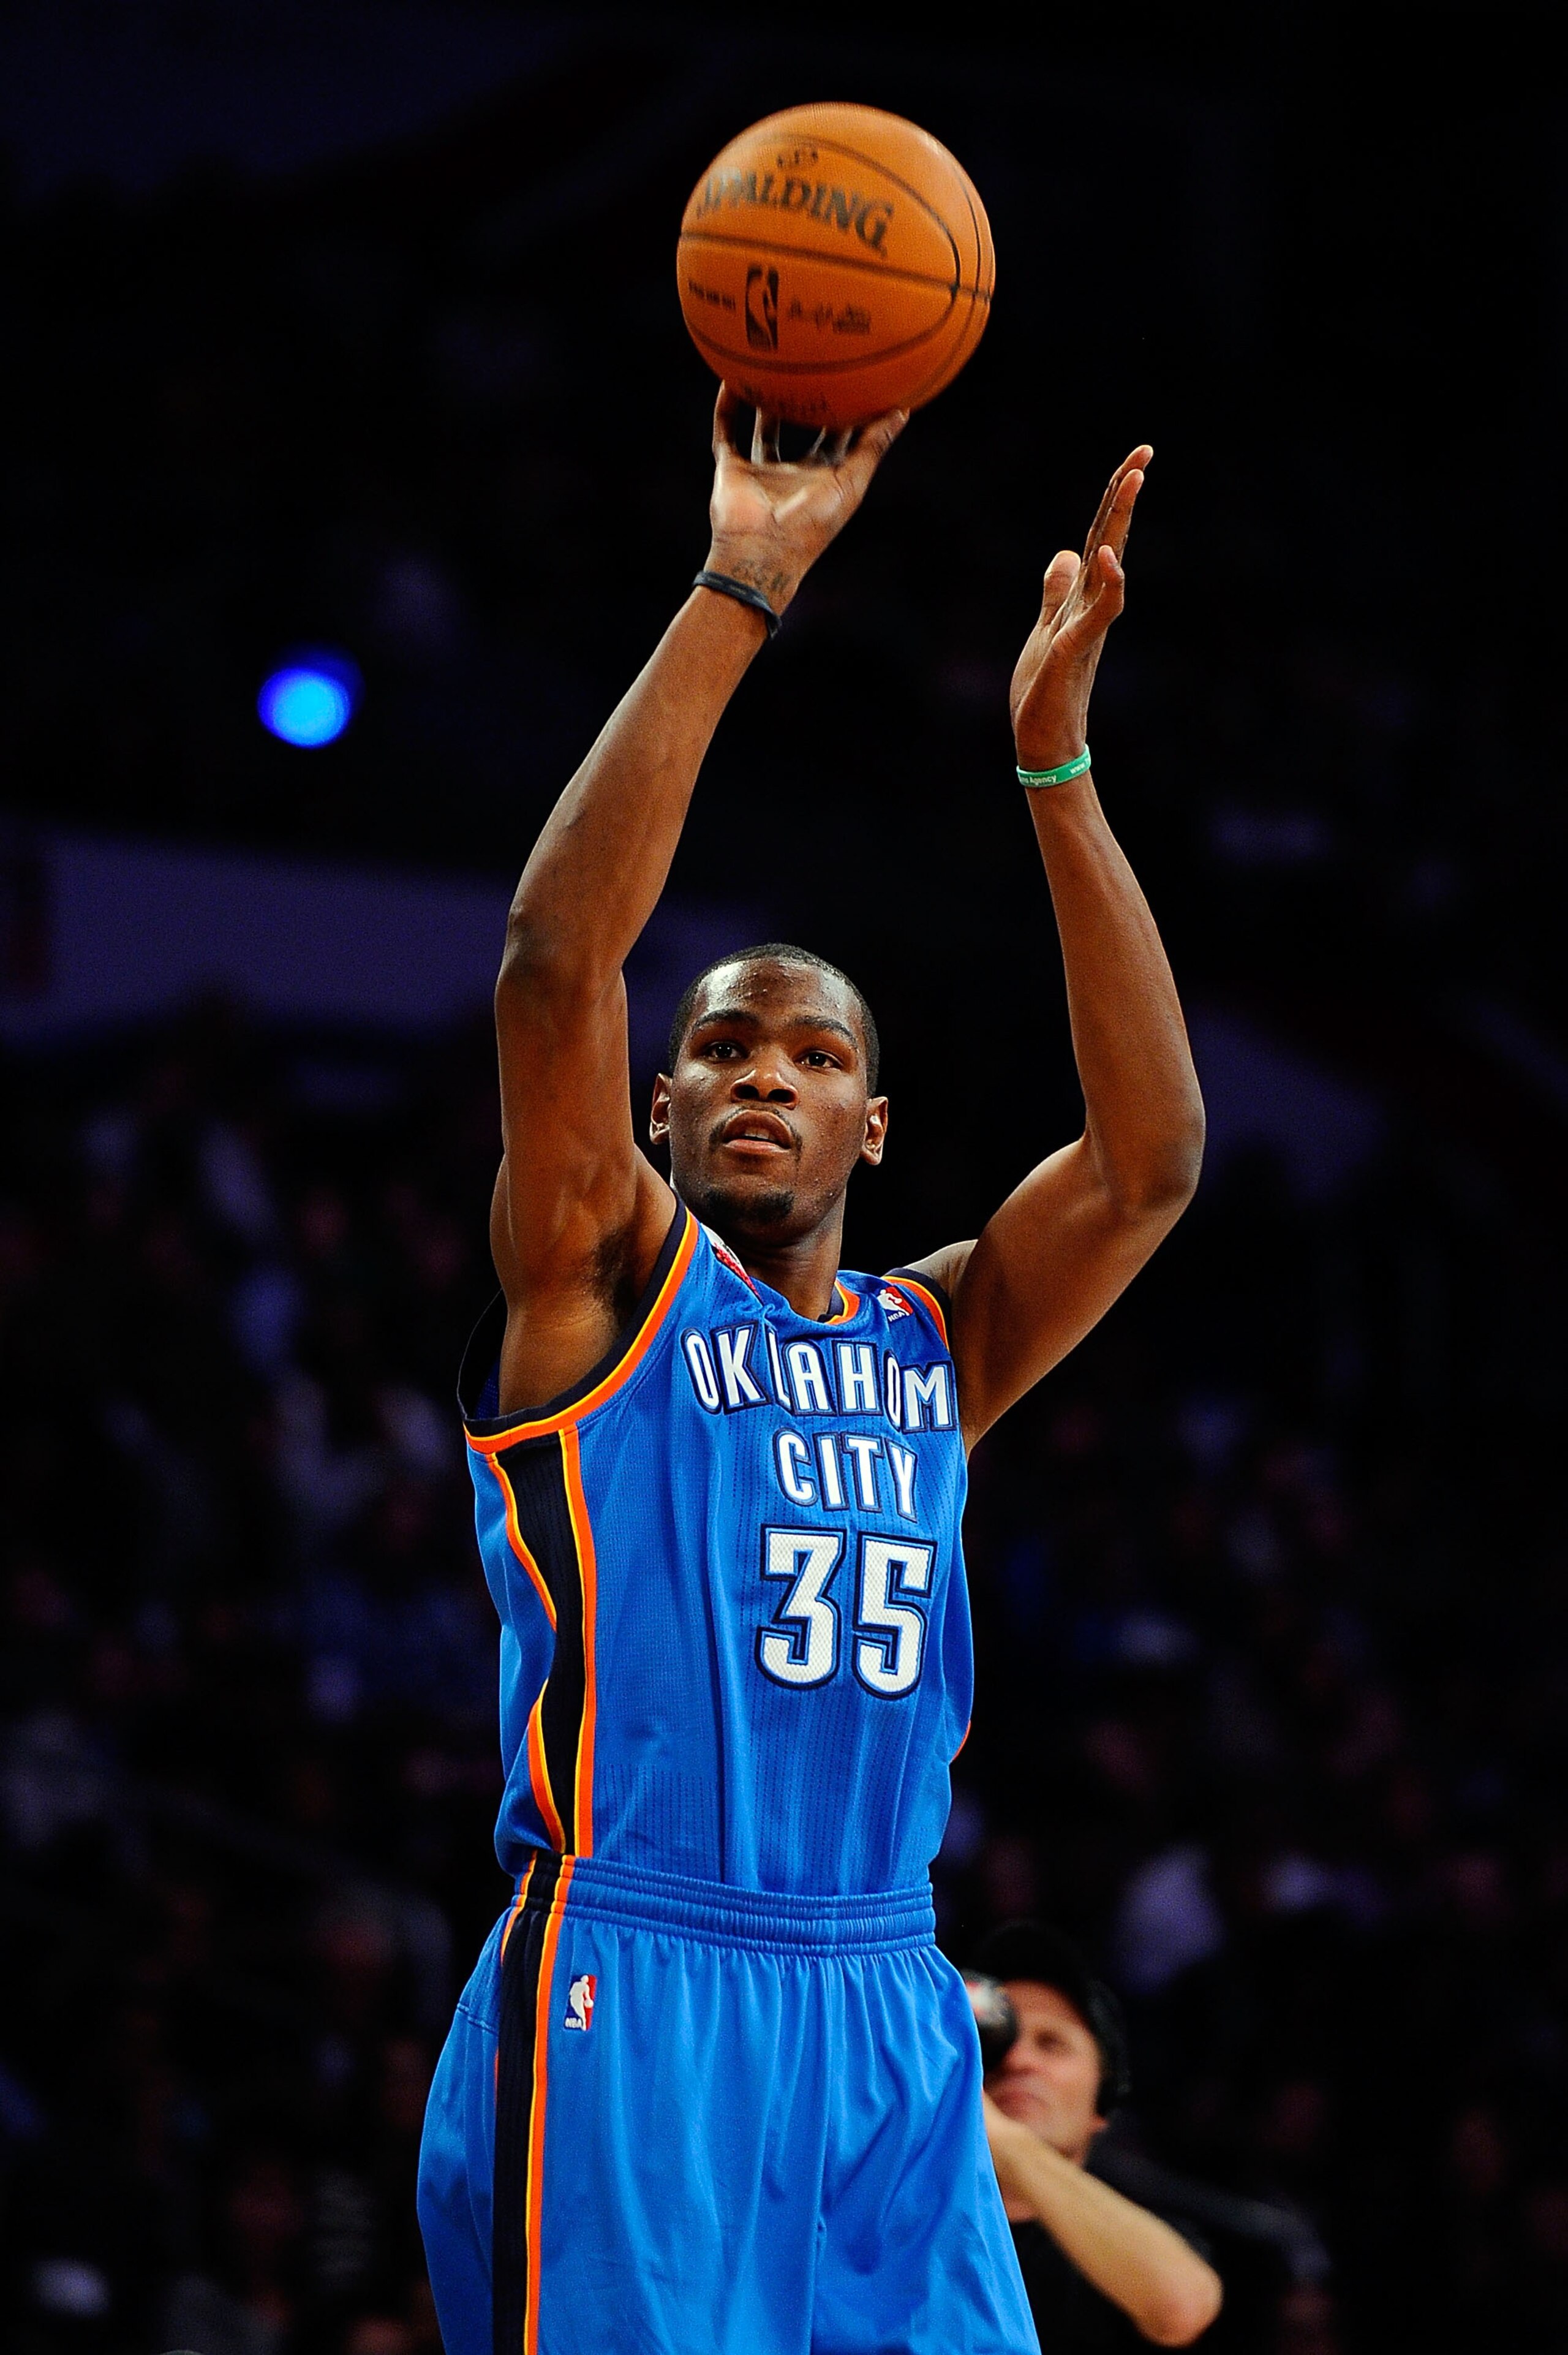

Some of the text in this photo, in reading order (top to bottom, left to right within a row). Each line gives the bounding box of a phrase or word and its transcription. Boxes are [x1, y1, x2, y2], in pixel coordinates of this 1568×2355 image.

[1030, 775, 1057, 786] Agency
[888, 1311, 905, 1322] NBA
[773, 1427, 918, 1523] CITY
[755, 1524, 938, 1701] 35
